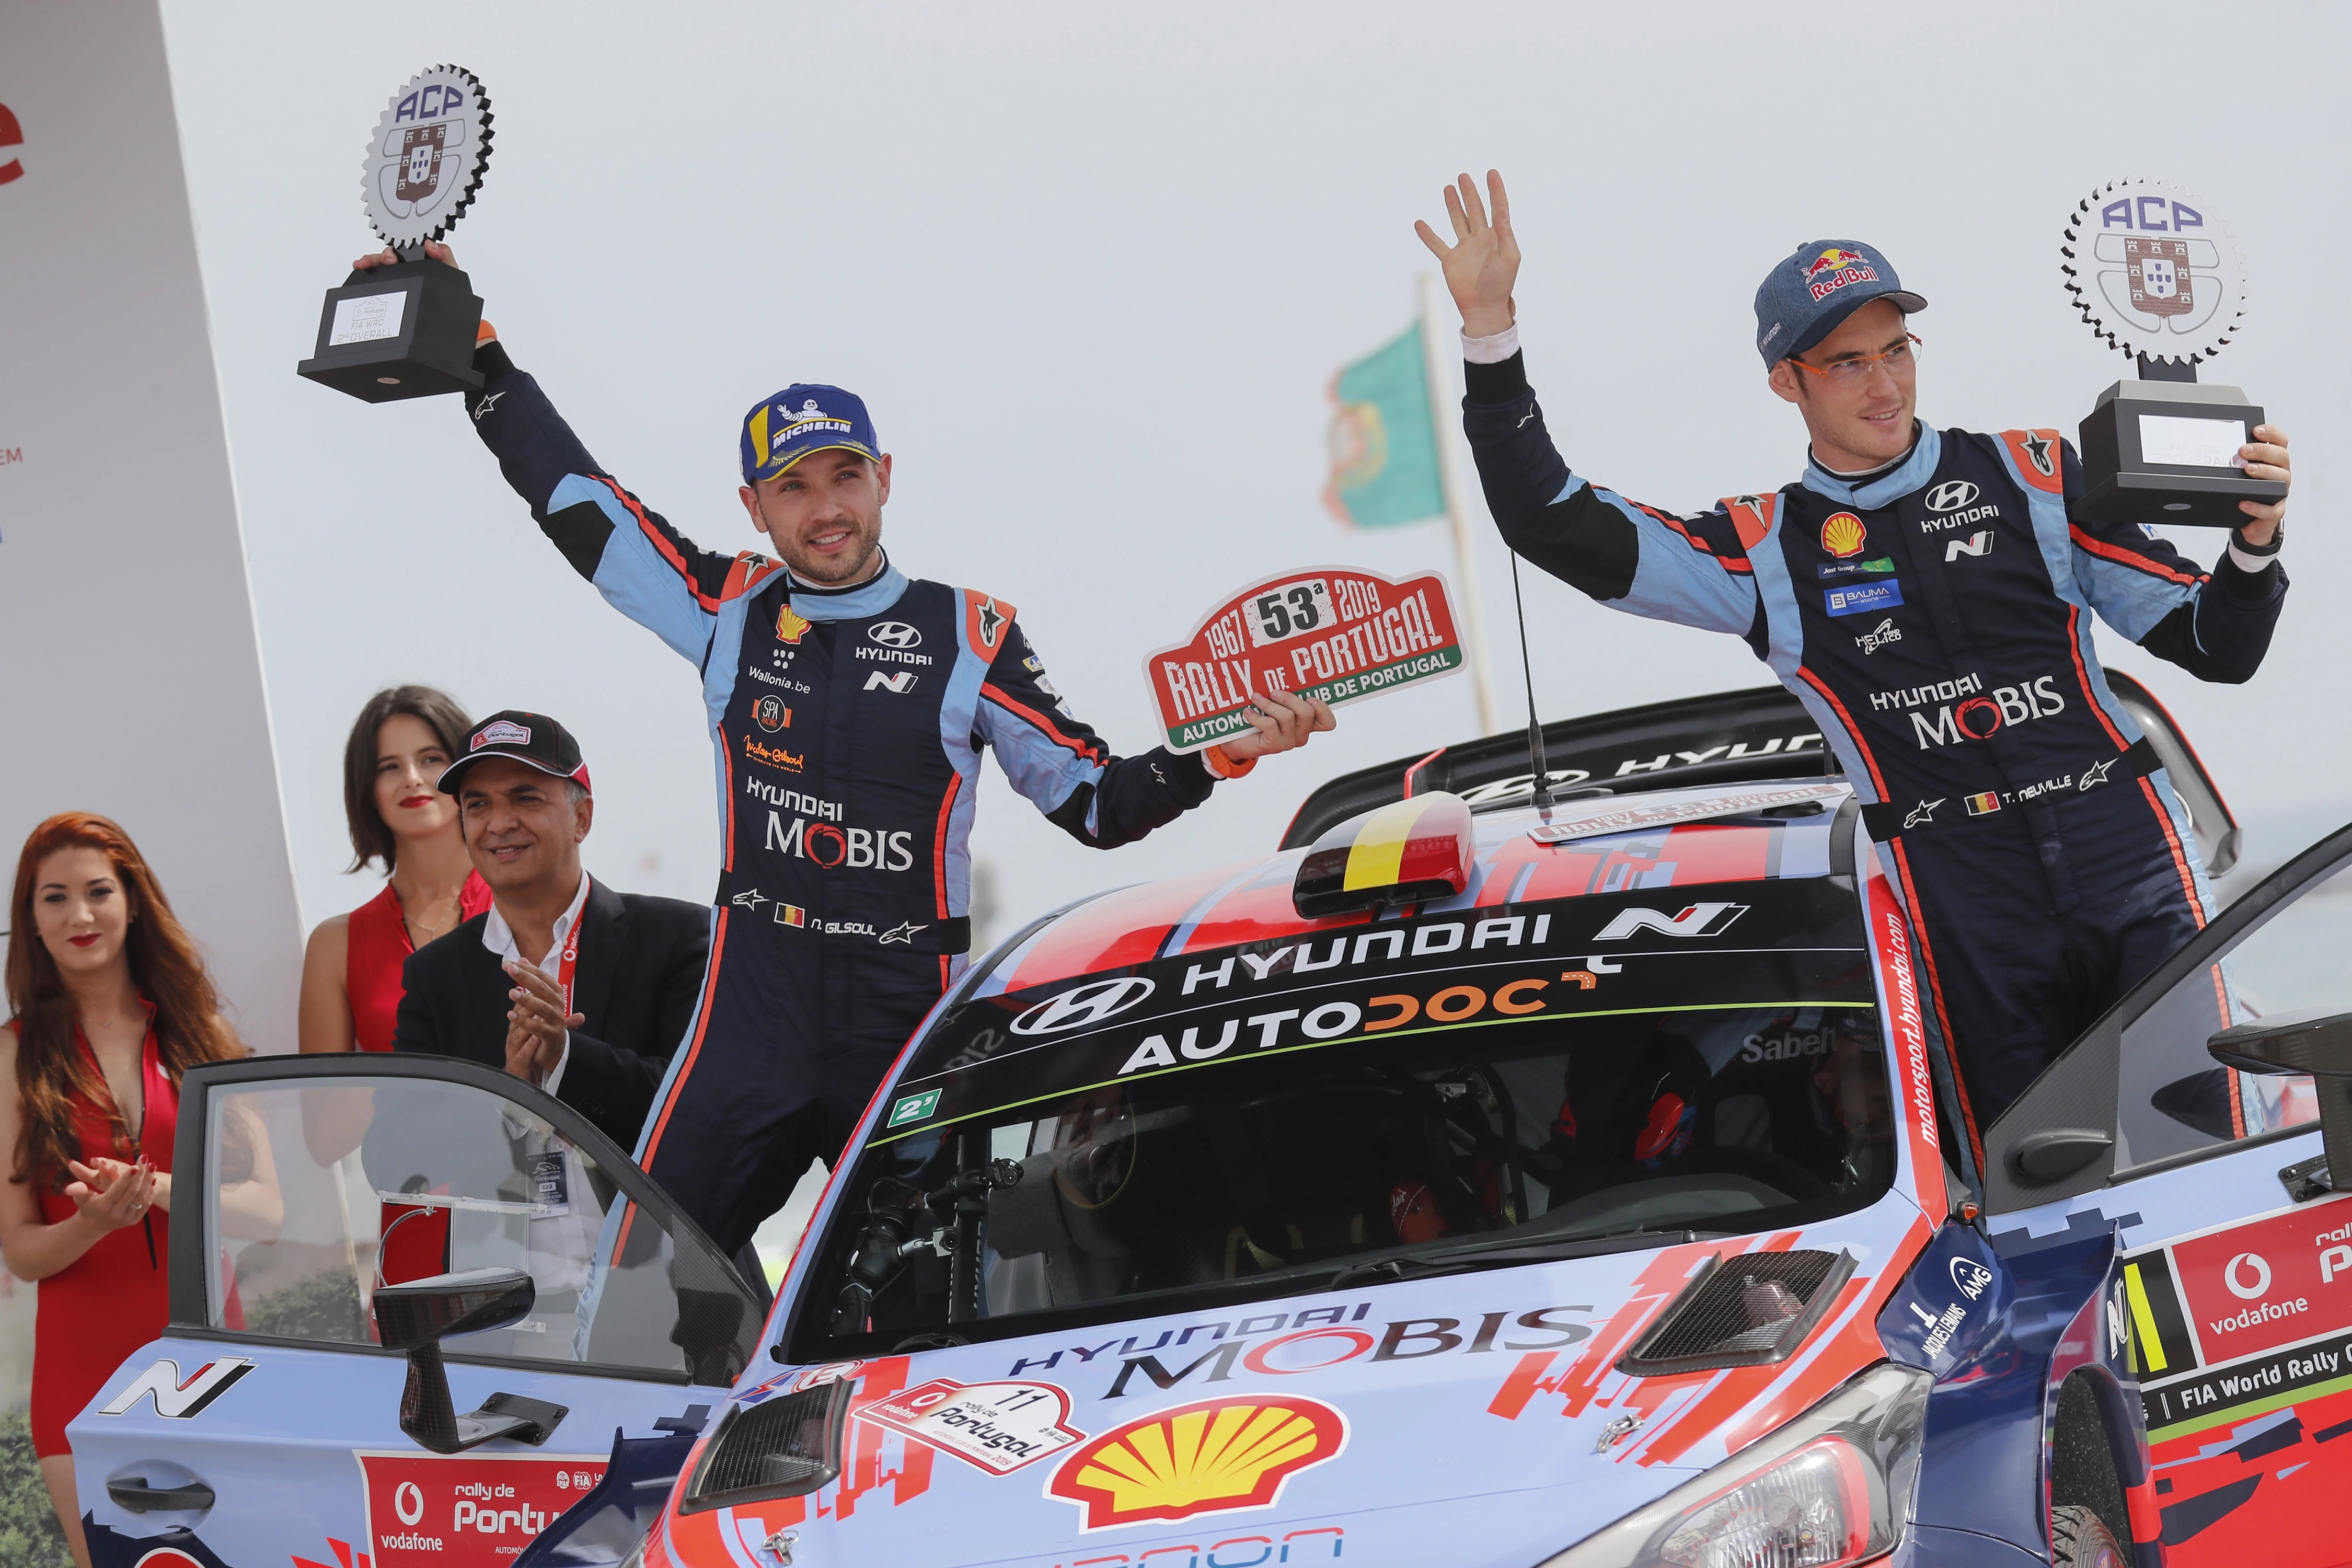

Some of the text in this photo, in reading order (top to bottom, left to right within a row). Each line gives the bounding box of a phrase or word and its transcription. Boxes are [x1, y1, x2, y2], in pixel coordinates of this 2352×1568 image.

[395, 85, 464, 123] ACP
[2102, 196, 2203, 232] ACP
[1809, 266, 1880, 302] Red Bull
[350, 328, 393, 342] OVERALL
[351, 318, 384, 330] FIA WRC
[1762, 322, 1781, 347] HYUNDAI
[773, 421, 852, 449] MICHELIN
[1920, 504, 2000, 533] HYUNDAI
[1846, 587, 1889, 601] BAUMA
[1204, 608, 1247, 661] 1967
[1334, 578, 1383, 622] 2019
[855, 647, 933, 666] HYUNDAI
[1163, 588, 1444, 721] RALLY DE PORTUGAL
[748, 665, 811, 695] Wallonia.be
[1333, 678, 1358, 698] DE
[1359, 652, 1452, 688] PORTUGAL
[1869, 672, 1984, 711] HYUNDAI
[761, 714, 777, 728] RACING
[762, 699, 779, 721] SPA
[1908, 675, 2066, 751] MOBIS
[746, 775, 844, 822] HYUNDAI
[2002, 775, 2072, 804] T. NEUVILLE
[764, 810, 914, 872] MOBIS
[1548, 817, 1634, 835] RALLY
[810, 918, 877, 936] N. GILSOUL
[1180, 914, 1552, 996] HYUNDAI
[1116, 978, 1551, 1075] AUTODOC
[1742, 1025, 1839, 1063] Sabelt
[1886, 913, 1937, 1149] motorsport.hyundai.com
[1962, 1267, 1993, 1301] AMG
[1921, 1302, 1967, 1360] JACQUES LEMANS
[2209, 1297, 2309, 1335] vodafone
[1008, 1302, 1373, 1377] HYUNDAI
[1098, 1304, 1594, 1401] MOBIS
[2180, 1383, 2218, 1410] FIA
[2219, 1364, 2282, 1398] World
[2287, 1351, 2339, 1380] Rally
[881, 1403, 919, 1420] vodafone
[958, 1401, 999, 1418] rally de
[994, 1389, 1050, 1412] 11
[928, 1407, 1044, 1458] Portugal
[991, 1455, 1013, 1466] 2019
[455, 1482, 515, 1501] rally de
[381, 1532, 443, 1551] vodafone
